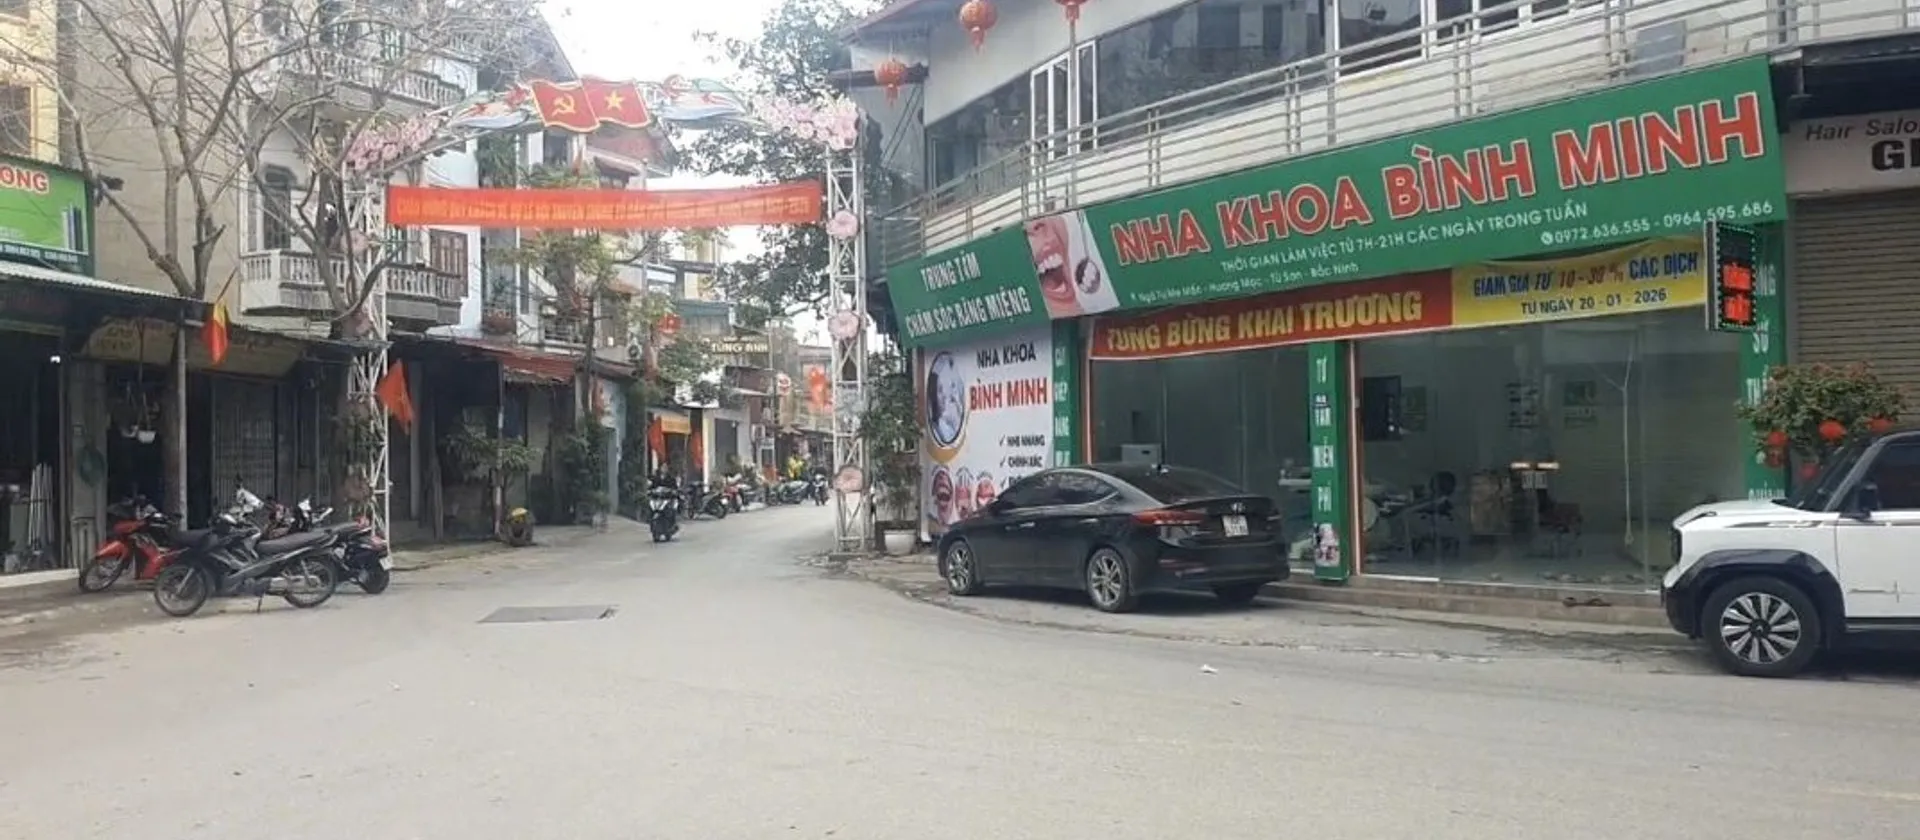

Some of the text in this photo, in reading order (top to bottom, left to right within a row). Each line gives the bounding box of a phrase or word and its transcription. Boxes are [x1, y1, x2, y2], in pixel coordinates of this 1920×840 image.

[1806, 116, 1920, 141] Hair Salo
[1110, 92, 1764, 266] NHA KHOA BÌNH MINH
[1251, 253, 1280, 269] GIAN
[1281, 247, 1308, 264] LÀM
[1308, 242, 1338, 259] VIỆC
[1357, 231, 1405, 251] 7H-21H
[1406, 226, 1439, 244] CÁC
[1441, 214, 1485, 239] NGÀY
[1486, 209, 1542, 232] TRONG
[1554, 217, 1651, 243] 0972.636.555
[1606, 294, 1622, 306] 01
[1634, 287, 1667, 304] 2026
[1238, 306, 1294, 340] KHAI
[977, 345, 1000, 368] NHA
[1002, 342, 1037, 364] KHOA
[970, 378, 1003, 411] BÌNH
[1006, 377, 1048, 407] MINH
